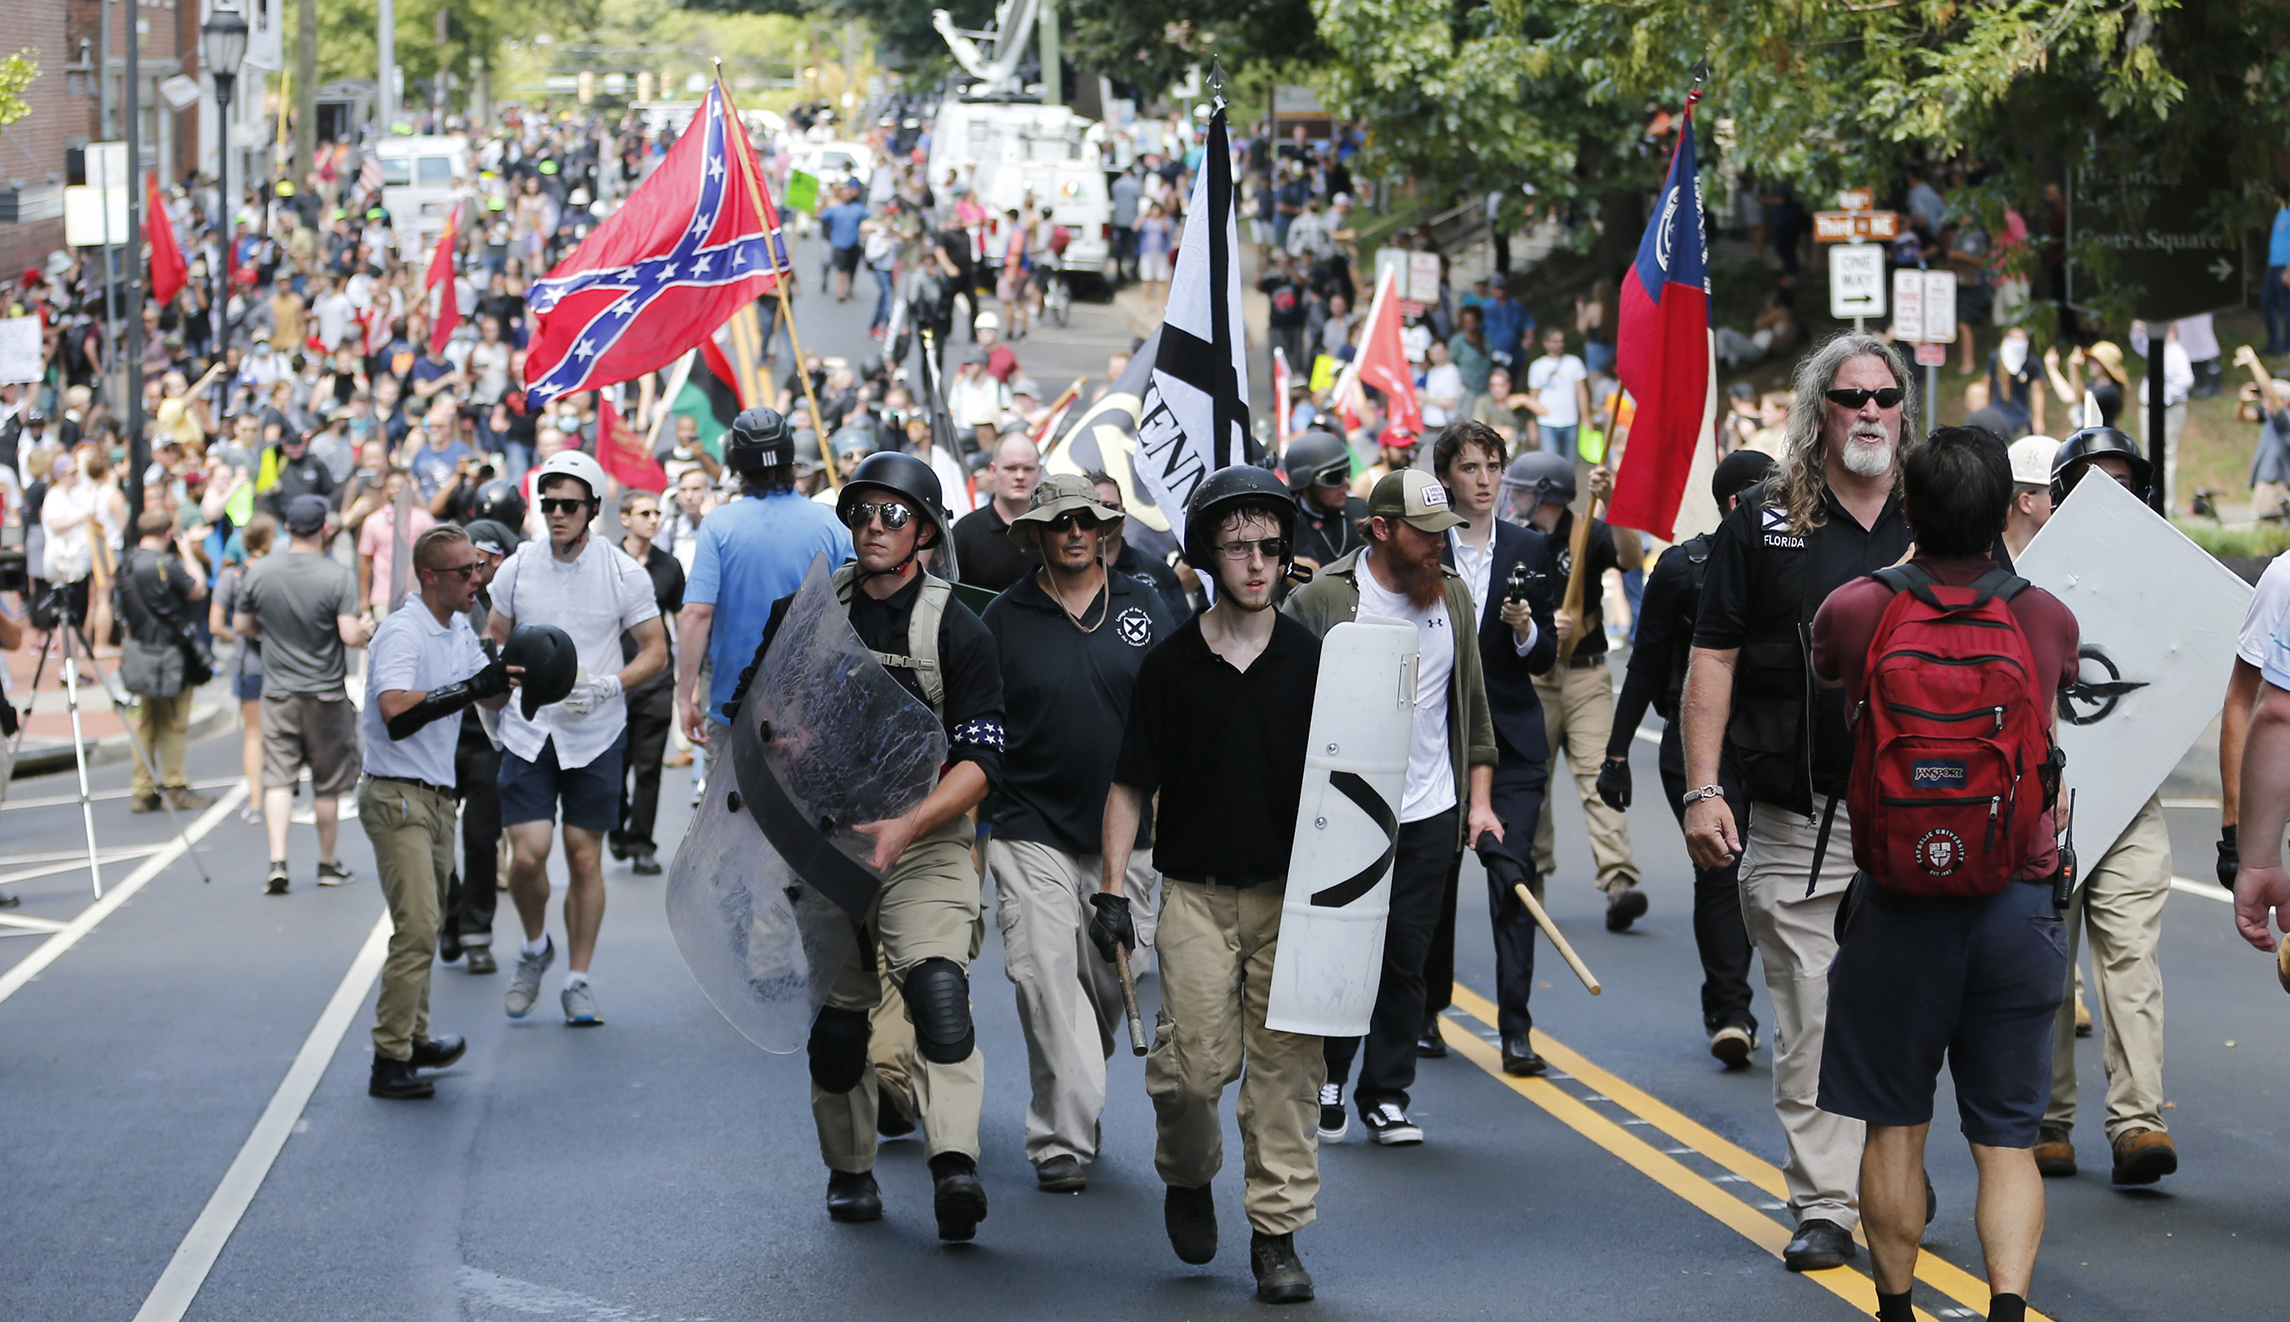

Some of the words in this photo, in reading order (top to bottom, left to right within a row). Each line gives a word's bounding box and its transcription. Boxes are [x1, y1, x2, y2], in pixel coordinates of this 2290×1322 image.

[1816, 217, 1856, 236] Third
[1870, 215, 1894, 236] NE
[2146, 228, 2222, 255] Square
[1763, 534, 1805, 548] FLORIDA
[1915, 831, 1933, 864] CATHOLIC
[1935, 829, 1965, 862] UNIVERSITY
